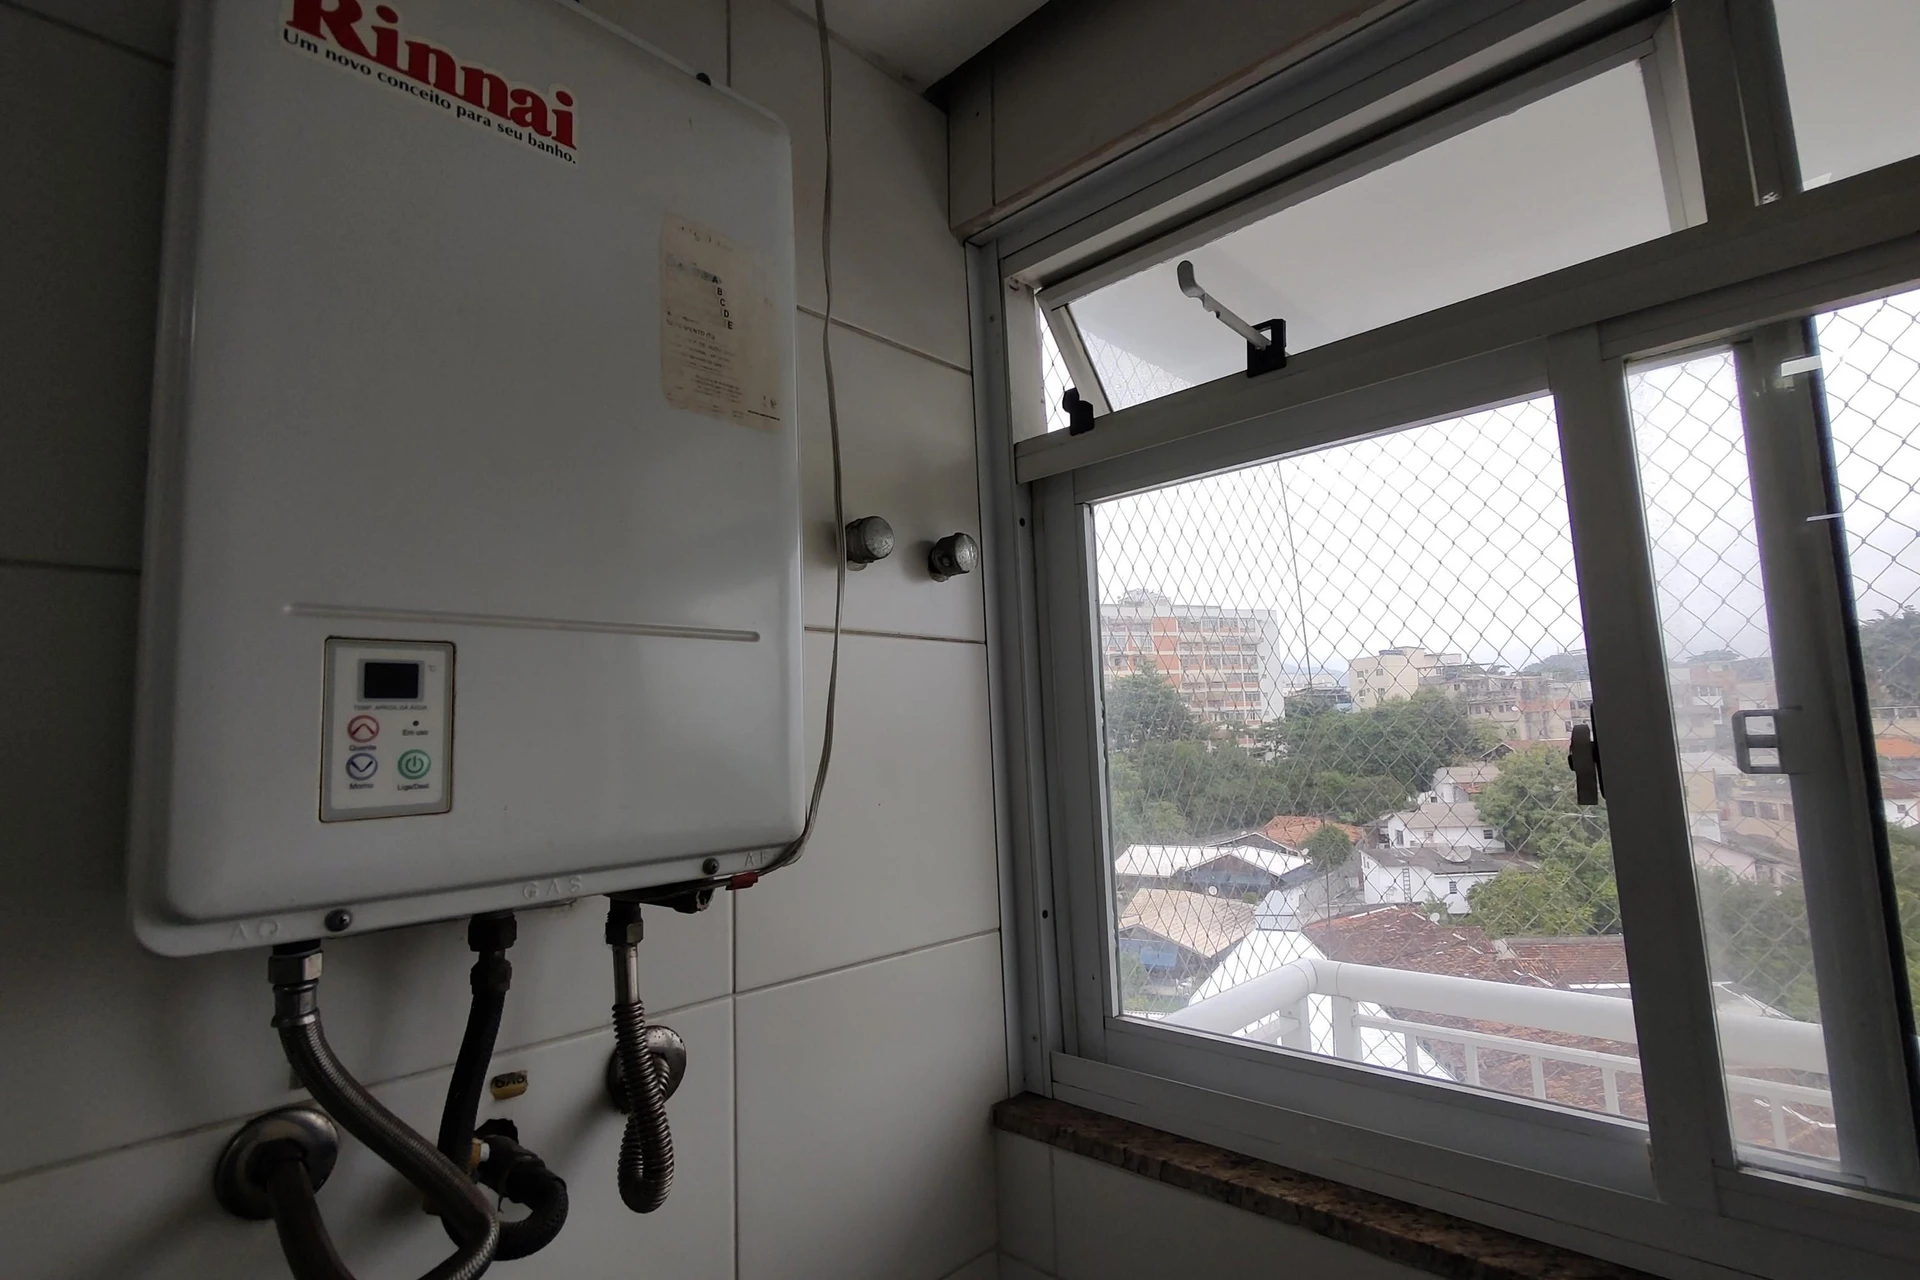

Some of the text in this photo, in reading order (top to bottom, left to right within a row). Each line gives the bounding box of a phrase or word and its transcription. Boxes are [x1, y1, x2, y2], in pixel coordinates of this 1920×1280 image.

[286, 0, 577, 150] Rinnai
[283, 28, 577, 164] Um novo conceito para seu banho.
[716, 287, 723, 296] B
[719, 298, 726, 307] C
[723, 309, 730, 318] D
[727, 320, 733, 330] E
[522, 875, 583, 900] GAS
